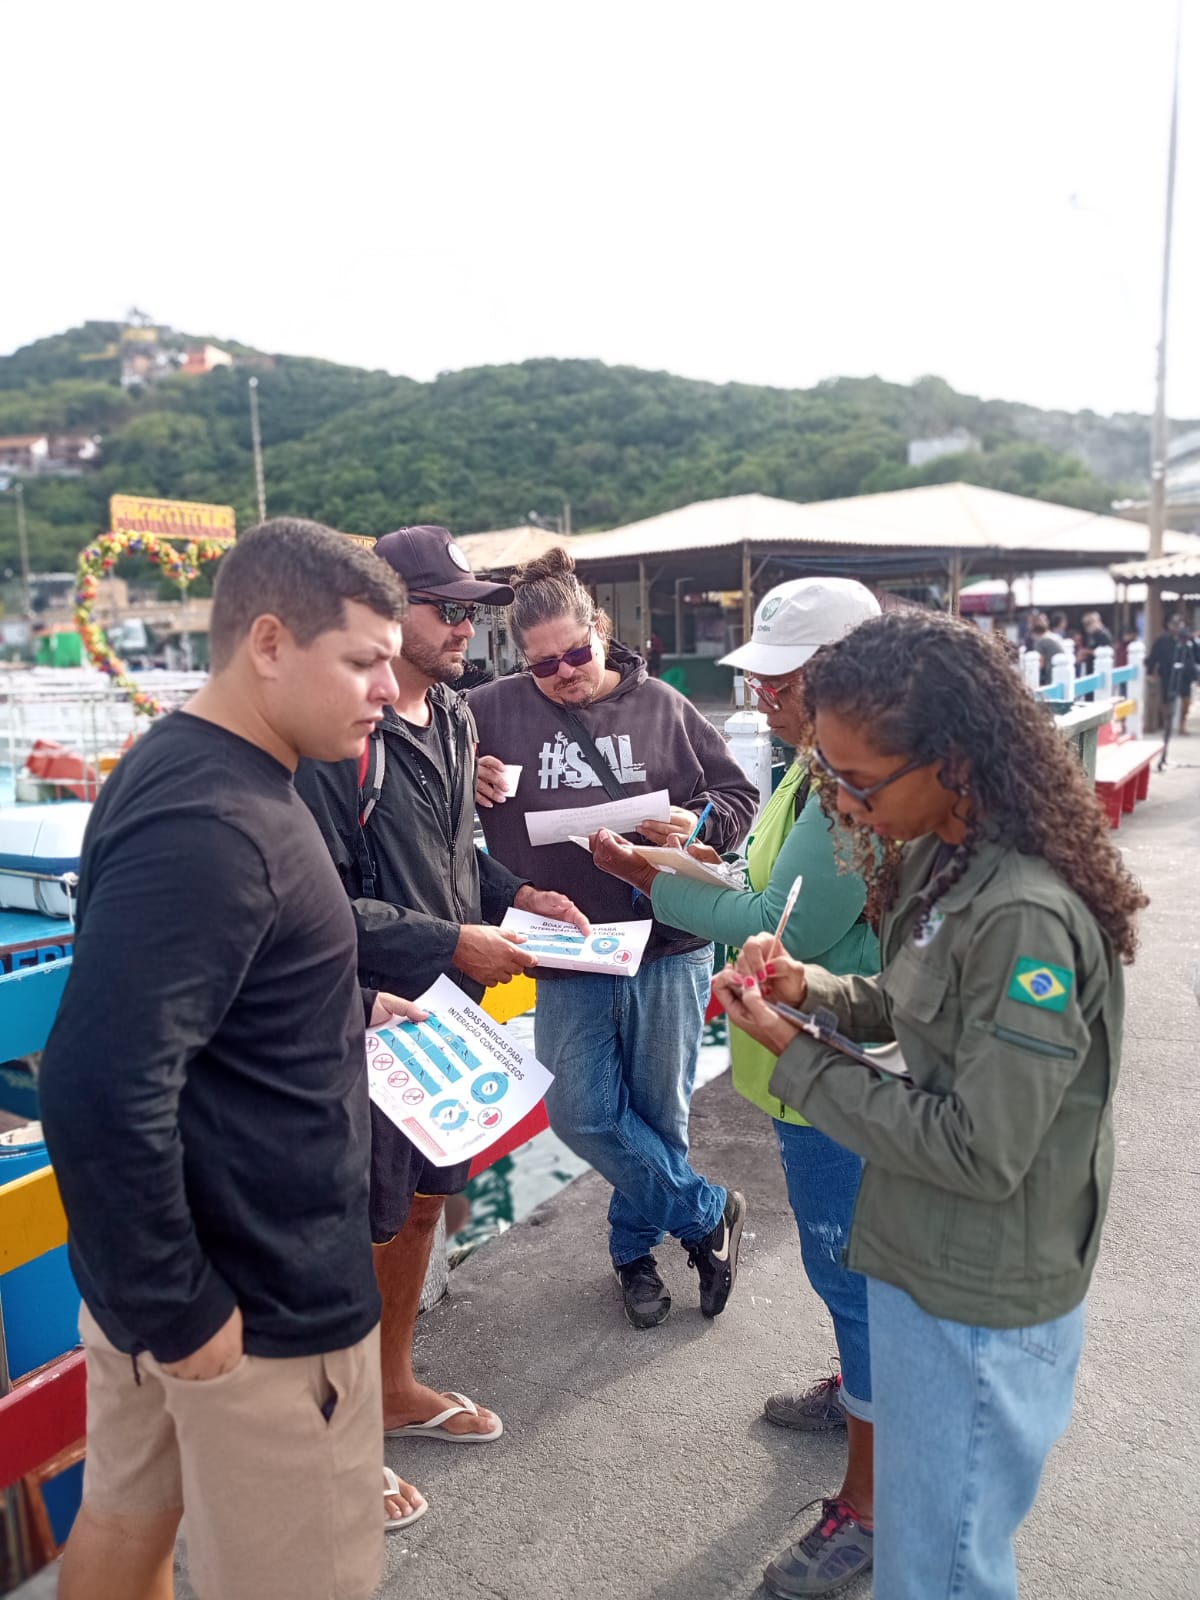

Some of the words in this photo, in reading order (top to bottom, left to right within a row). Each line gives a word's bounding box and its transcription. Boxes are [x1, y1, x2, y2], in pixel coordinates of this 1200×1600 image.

[447, 1007, 482, 1038] INTERAÇÃO
[480, 1036, 495, 1053] COM
[493, 1050, 525, 1081] CETÁCEOS
[463, 1006, 482, 1025] BOAS
[479, 1022, 509, 1050] PRÁTICAS
[506, 1047, 524, 1065] PARA
